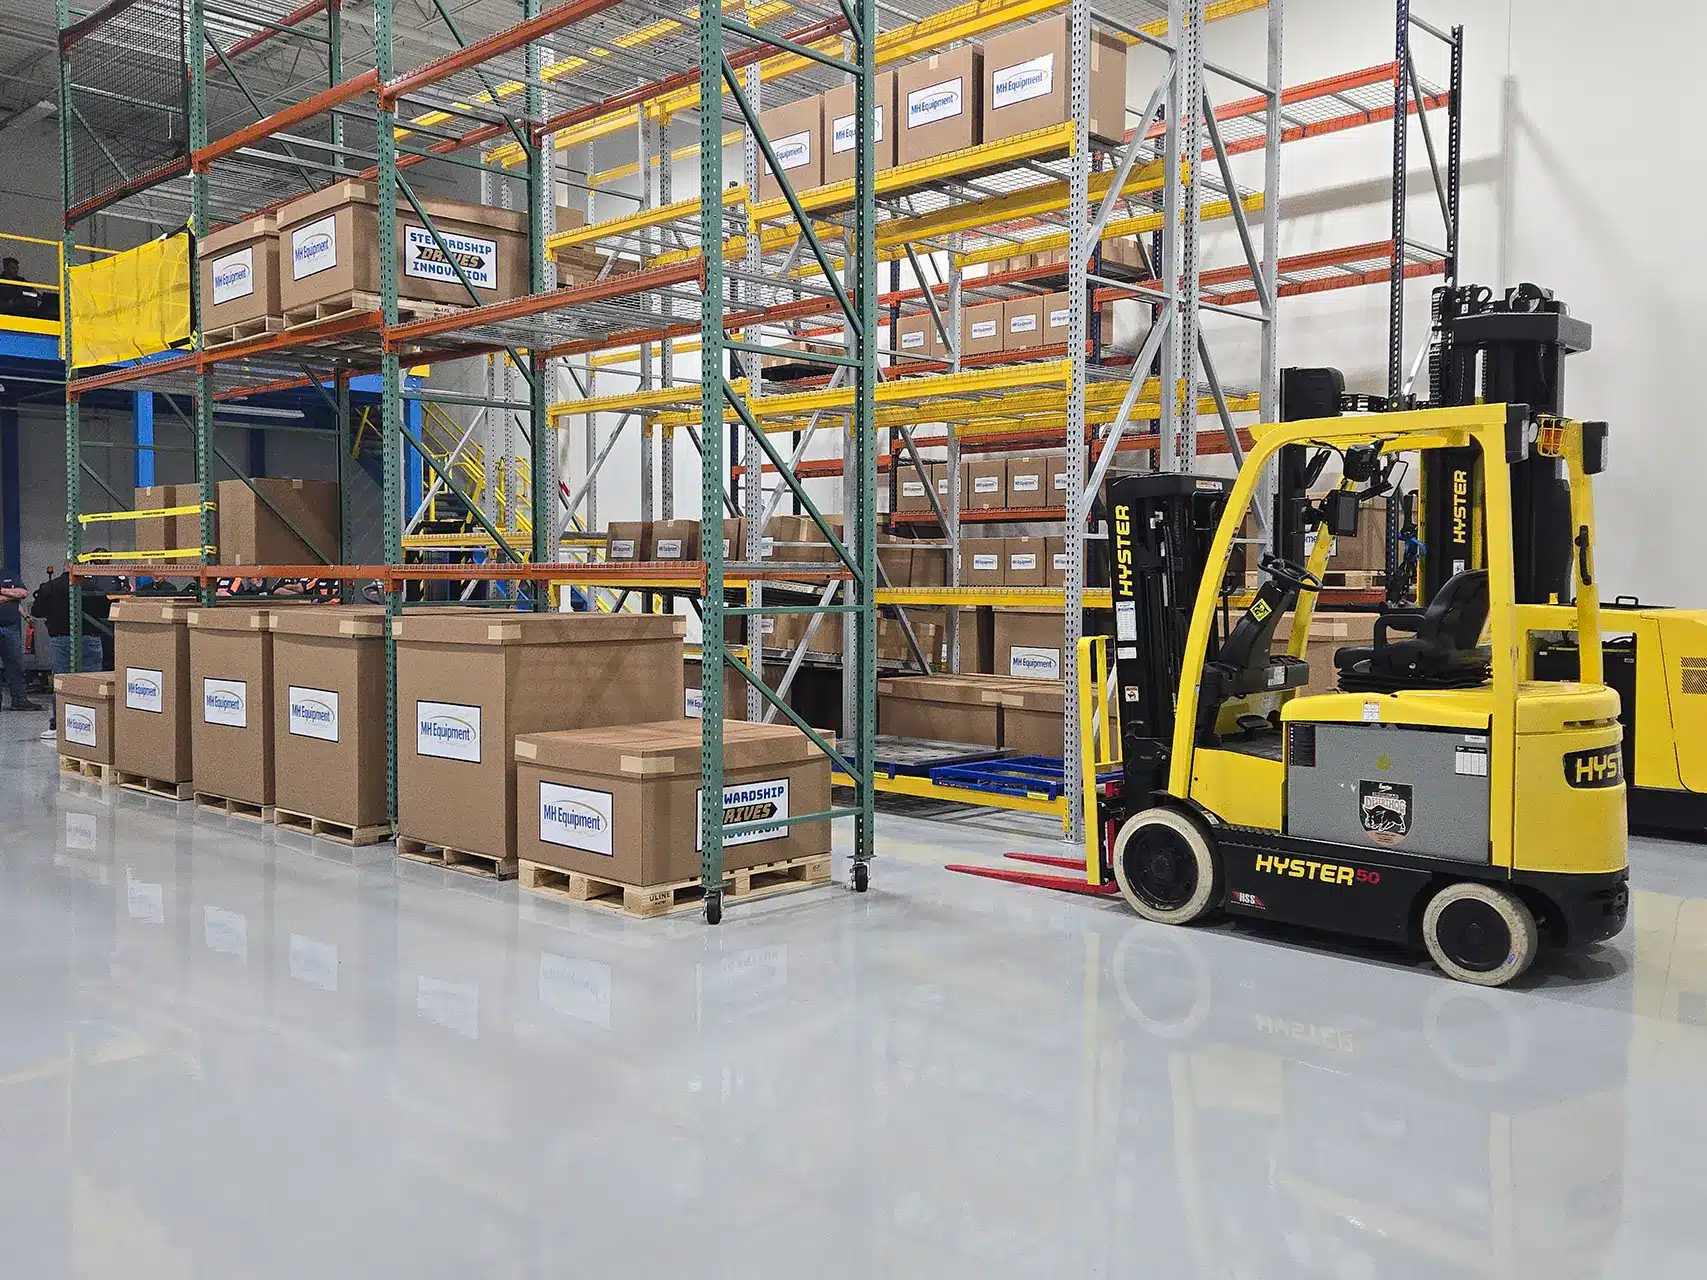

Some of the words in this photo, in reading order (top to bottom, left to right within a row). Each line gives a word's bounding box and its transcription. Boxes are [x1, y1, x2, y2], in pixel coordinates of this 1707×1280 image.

[996, 84, 1008, 95] MH
[1008, 72, 1043, 91] Equipment
[911, 105, 921, 115] MH
[921, 95, 954, 112] Equipment
[835, 130, 846, 141] MH
[295, 247, 304, 262] MH
[304, 238, 329, 260] Equipment
[410, 232, 492, 255] STERDSHIP
[215, 275, 223, 288] MH
[223, 268, 247, 287] Equipment
[412, 261, 488, 282] INNOVION
[1453, 469, 1467, 544] HYSTER
[1115, 504, 1133, 597] HYSTER
[1023, 658, 1052, 669] Equipment
[206, 695, 214, 707] MH
[214, 696, 240, 712] Equipment
[292, 704, 302, 718] MH
[302, 705, 331, 723] Equipment
[421, 721, 433, 736] MH
[433, 722, 470, 742] Equipment
[723, 786, 785, 805] WARDSHIP
[543, 804, 557, 821] MH
[557, 806, 601, 831] Equipment
[723, 803, 772, 823] RIVES
[1255, 853, 1355, 886] HYSTER
[1355, 868, 1381, 885] 50
